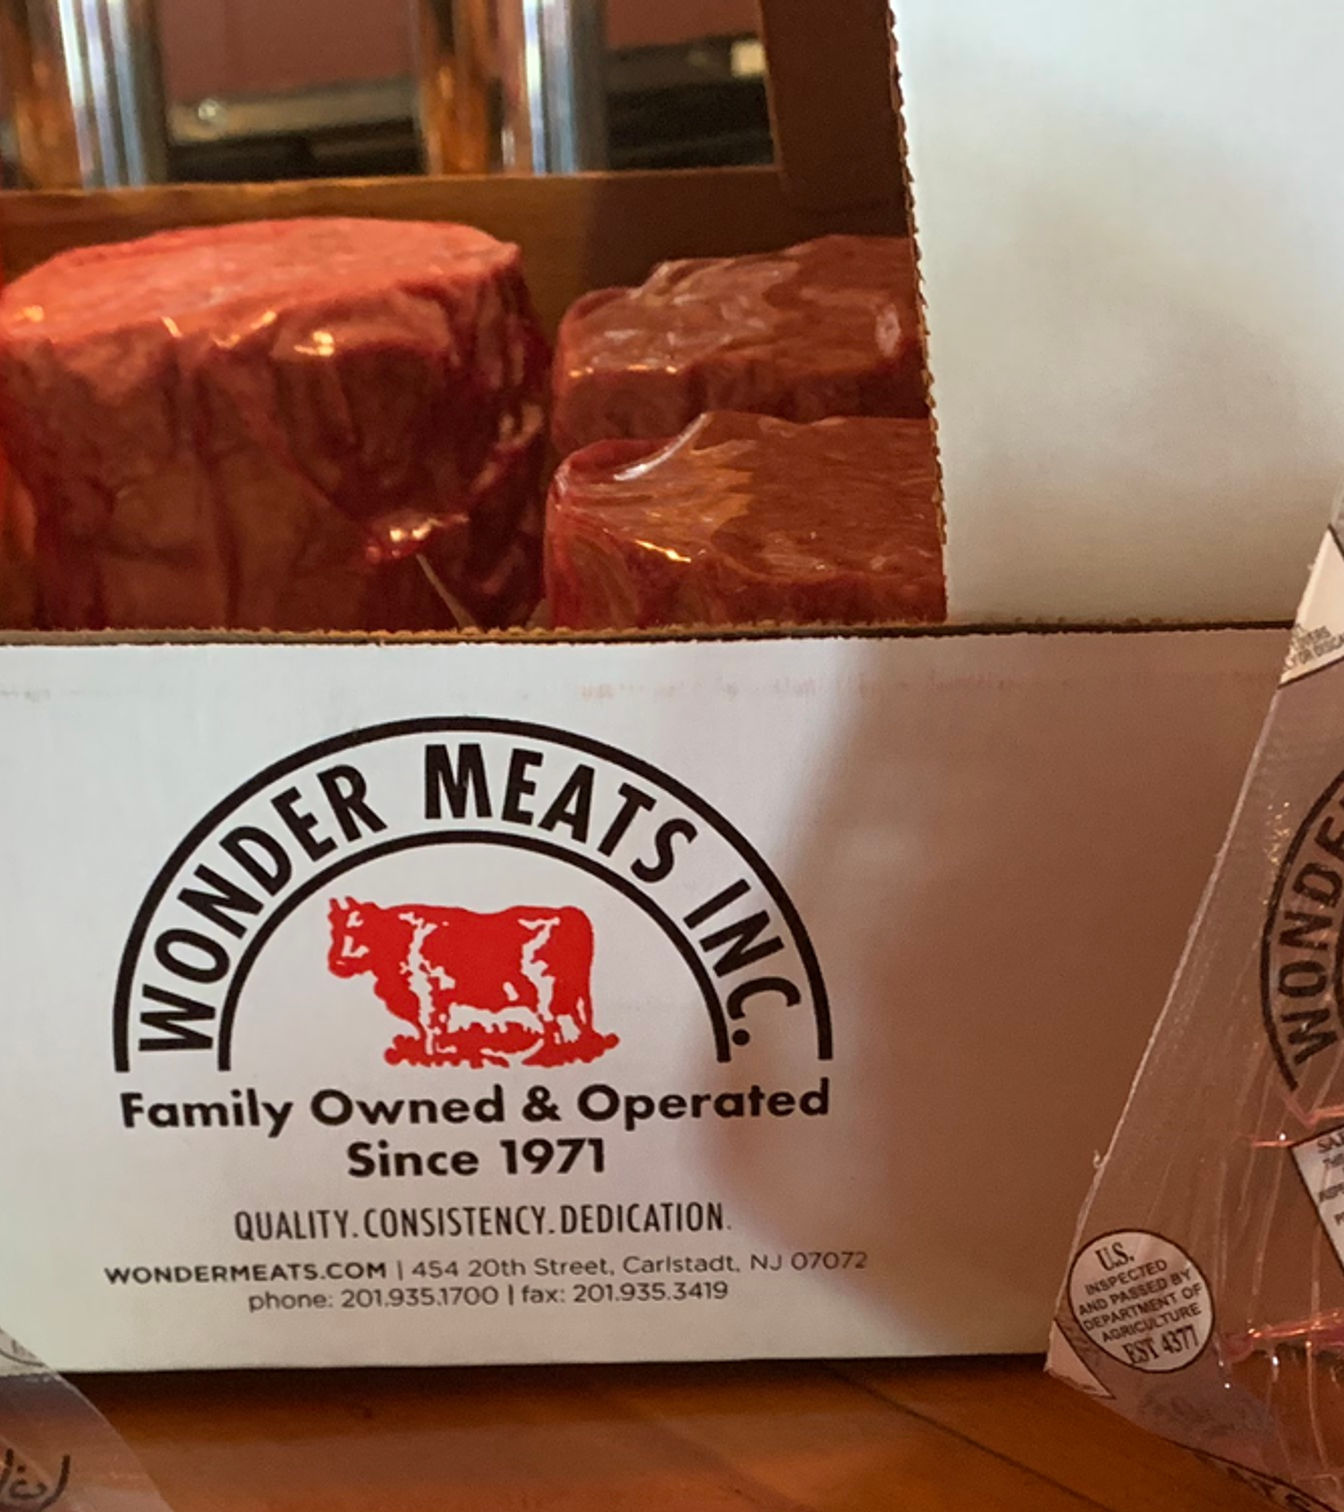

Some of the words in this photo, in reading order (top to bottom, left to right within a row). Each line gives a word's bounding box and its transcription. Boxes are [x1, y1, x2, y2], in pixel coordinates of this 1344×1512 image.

[139, 764, 388, 1052] WONDER
[423, 742, 698, 884] MEATS
[682, 879, 802, 1048] INC.
[119, 1088, 294, 1138] Family
[310, 1085, 505, 1127] Owned
[522, 1083, 561, 1122] &
[577, 1077, 832, 1132] Operated
[346, 1139, 479, 1179] Since
[500, 1137, 607, 1176] 1971
[103, 1261, 388, 1286] WONDERMEATS.COM
[411, 1260, 459, 1280] 454
[468, 1257, 527, 1279] 20th
[534, 1256, 616, 1279] Street,
[622, 1253, 741, 1277] Carlstadt,
[750, 1252, 784, 1273] NJ
[790, 1250, 869, 1272] 07072
[1095, 1242, 1135, 1272] U.S.
[248, 1291, 334, 1314] phone:
[340, 1286, 499, 1309] 201.935.1700
[522, 1285, 566, 1305] fax:
[573, 1280, 730, 1303] 201.935.3419
[1078, 1298, 1108, 1316] AND
[1109, 1277, 1168, 1305] PASSED
[1169, 1268, 1192, 1286] BY
[1084, 1259, 1168, 1296] INSPECTED
[1082, 1292, 1178, 1332] DEPARTMENT
[1181, 1282, 1203, 1300] OF
[1101, 1302, 1202, 1342] AGRICULTURE
[1122, 1338, 1159, 1364] EST
[1161, 1324, 1199, 1354] 4377
